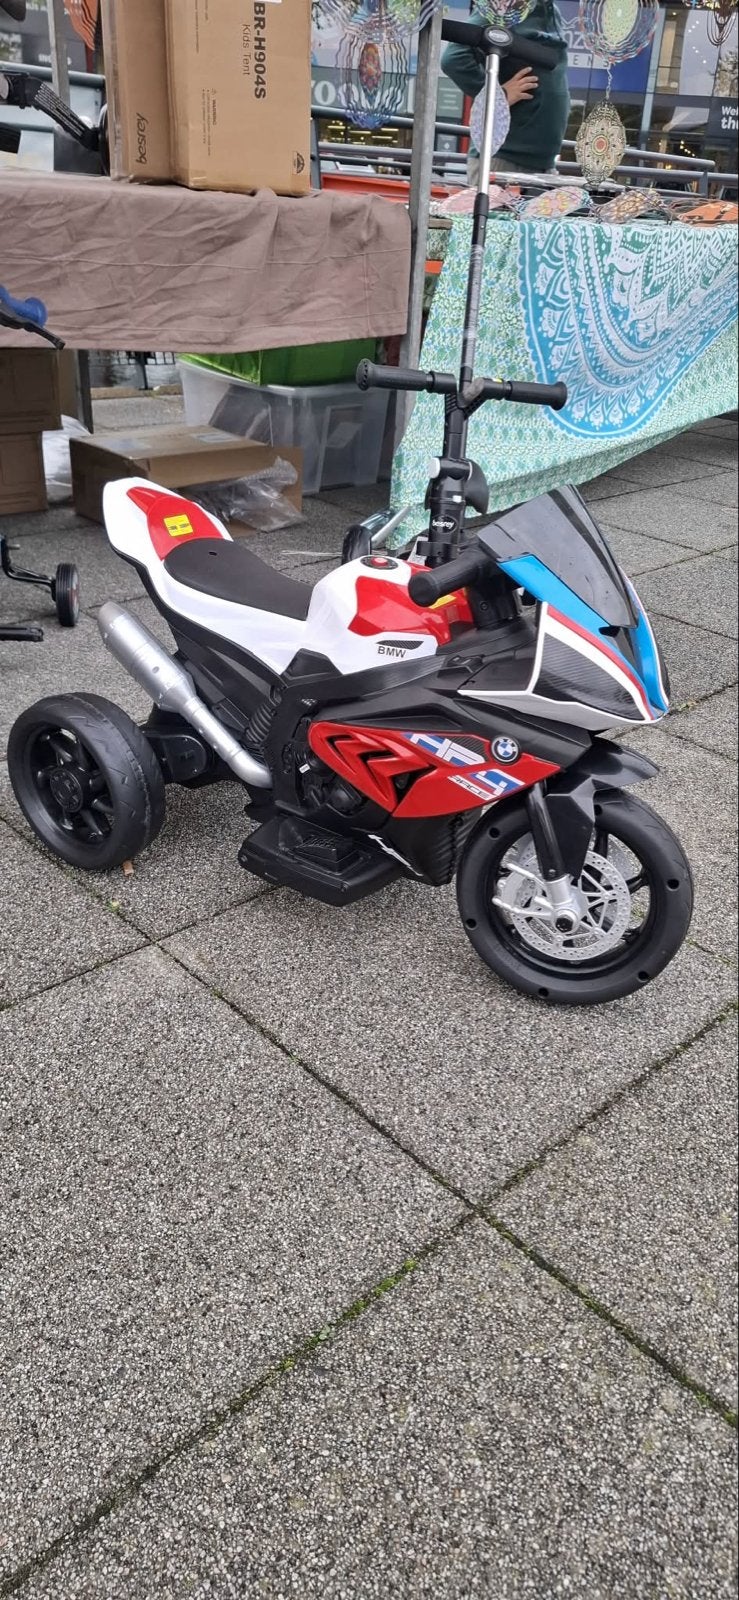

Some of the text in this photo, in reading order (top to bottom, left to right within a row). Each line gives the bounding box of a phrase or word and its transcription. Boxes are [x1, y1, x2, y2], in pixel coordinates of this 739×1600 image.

[242, 24, 251, 75] Kids Tent
[254, 2, 266, 99] BR-H904S
[135, 112, 149, 165] besrey
[377, 645, 407, 658] BMW
